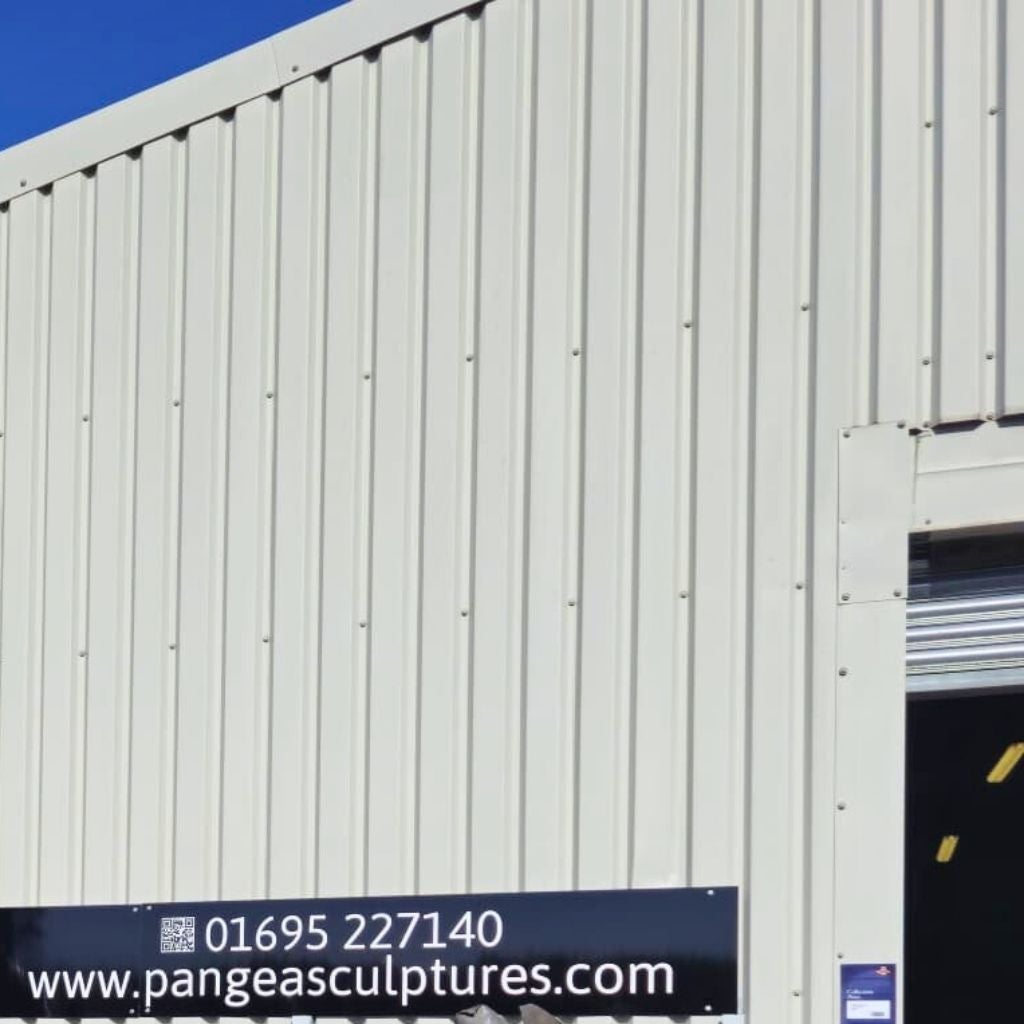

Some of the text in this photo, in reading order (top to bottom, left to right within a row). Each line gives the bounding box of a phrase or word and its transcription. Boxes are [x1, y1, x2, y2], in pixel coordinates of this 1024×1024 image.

[205, 909, 504, 954] 01695 227140
[27, 953, 674, 1008] www.pangeasculptures.com
